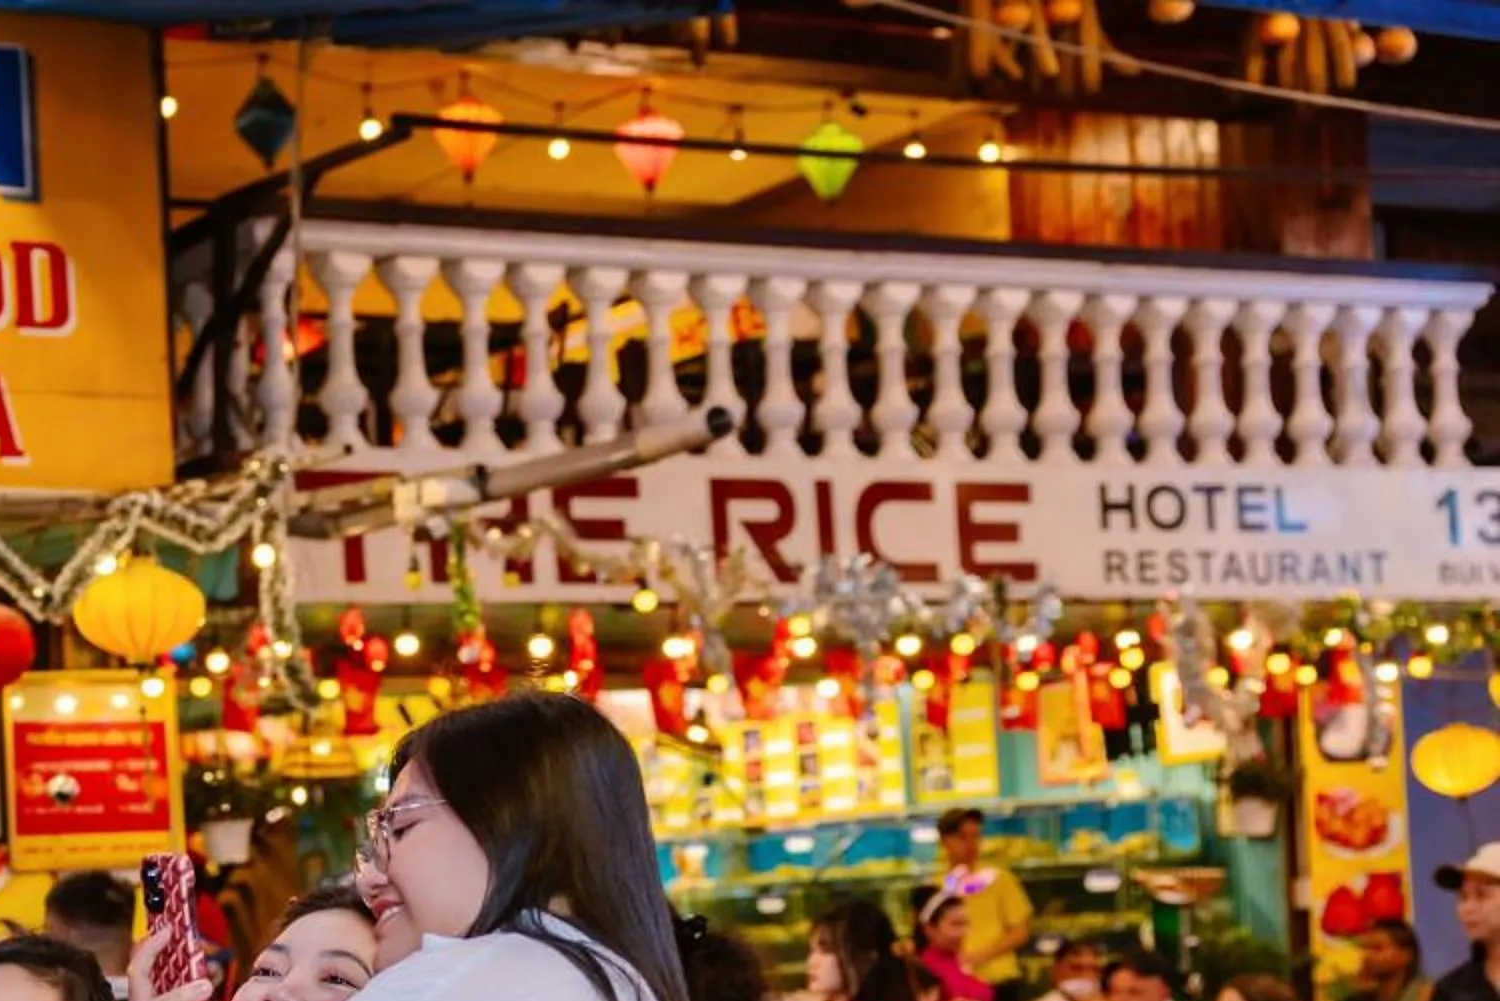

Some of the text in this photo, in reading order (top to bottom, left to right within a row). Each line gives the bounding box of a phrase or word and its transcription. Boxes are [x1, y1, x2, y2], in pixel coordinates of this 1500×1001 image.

[710, 479, 1037, 583] RICE
[1098, 482, 1308, 533] HOTEL
[1103, 549, 1390, 586] RESTAURANT
